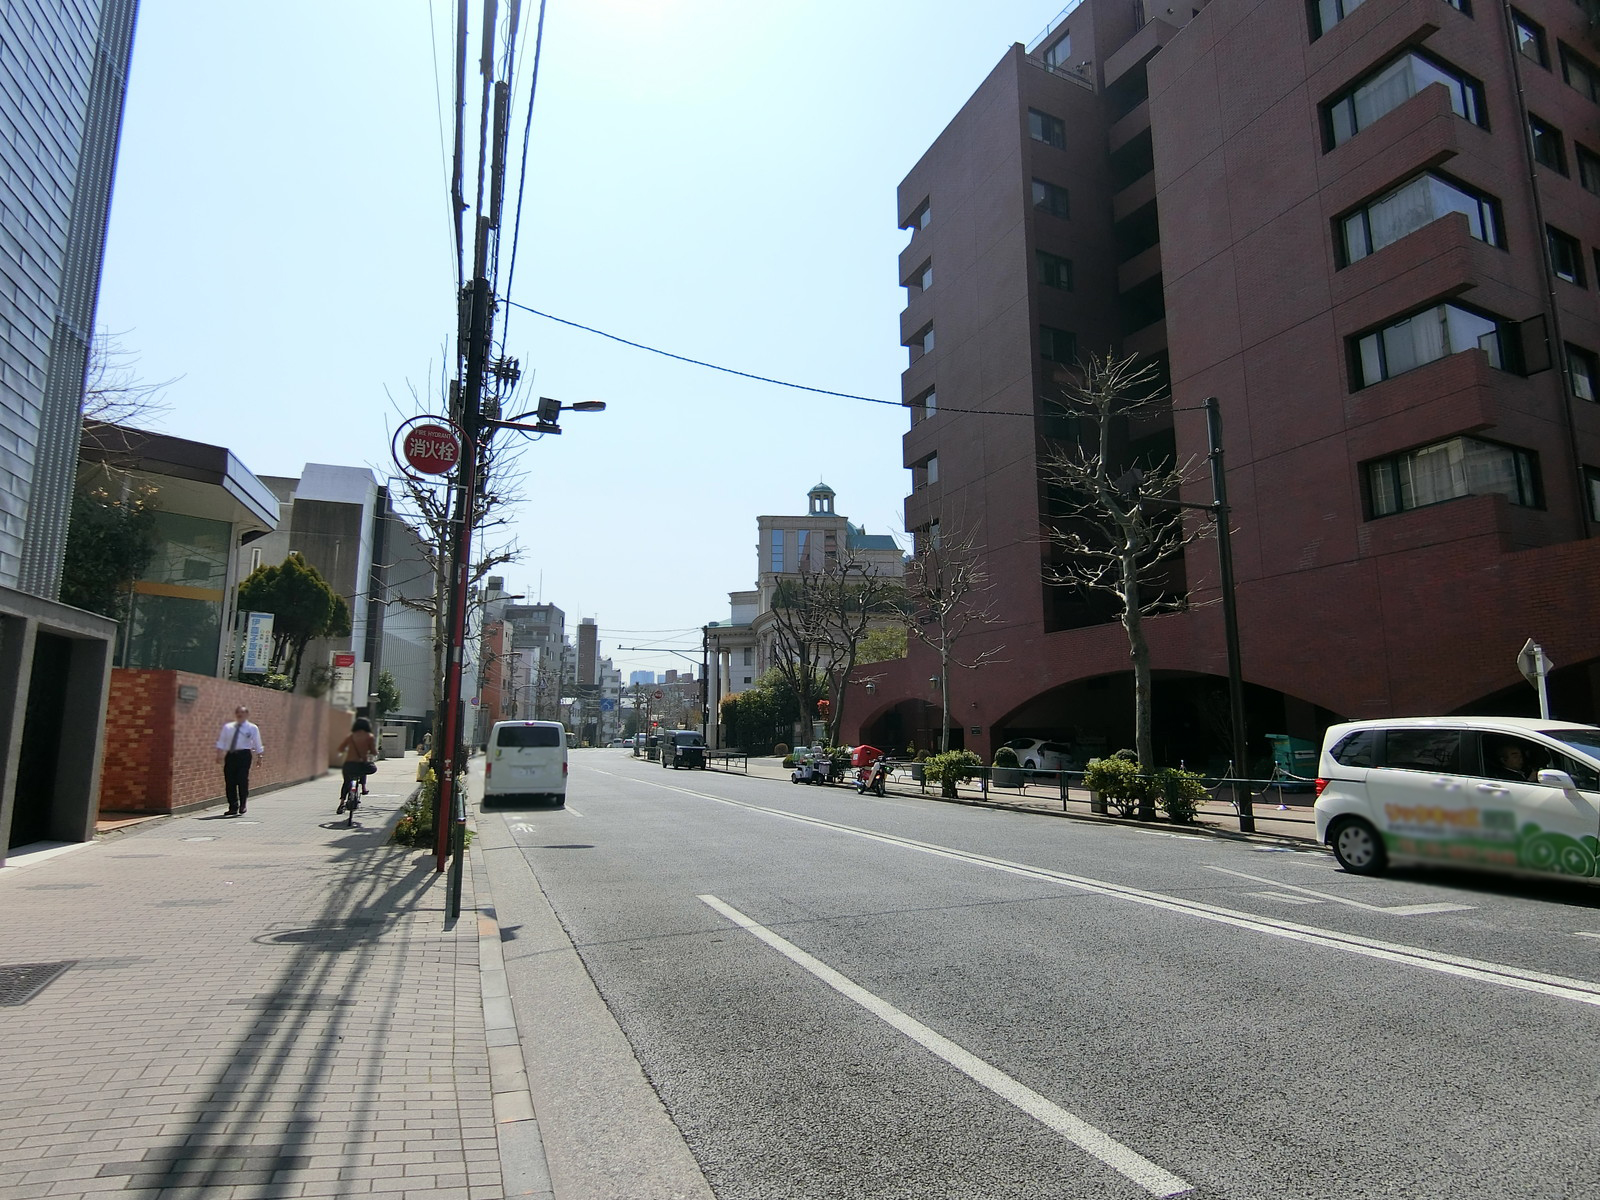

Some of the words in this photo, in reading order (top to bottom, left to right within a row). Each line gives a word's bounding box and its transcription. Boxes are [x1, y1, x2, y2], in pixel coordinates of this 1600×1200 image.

[428, 431, 451, 439] HYDRANT
[409, 438, 455, 462] 消火栓
